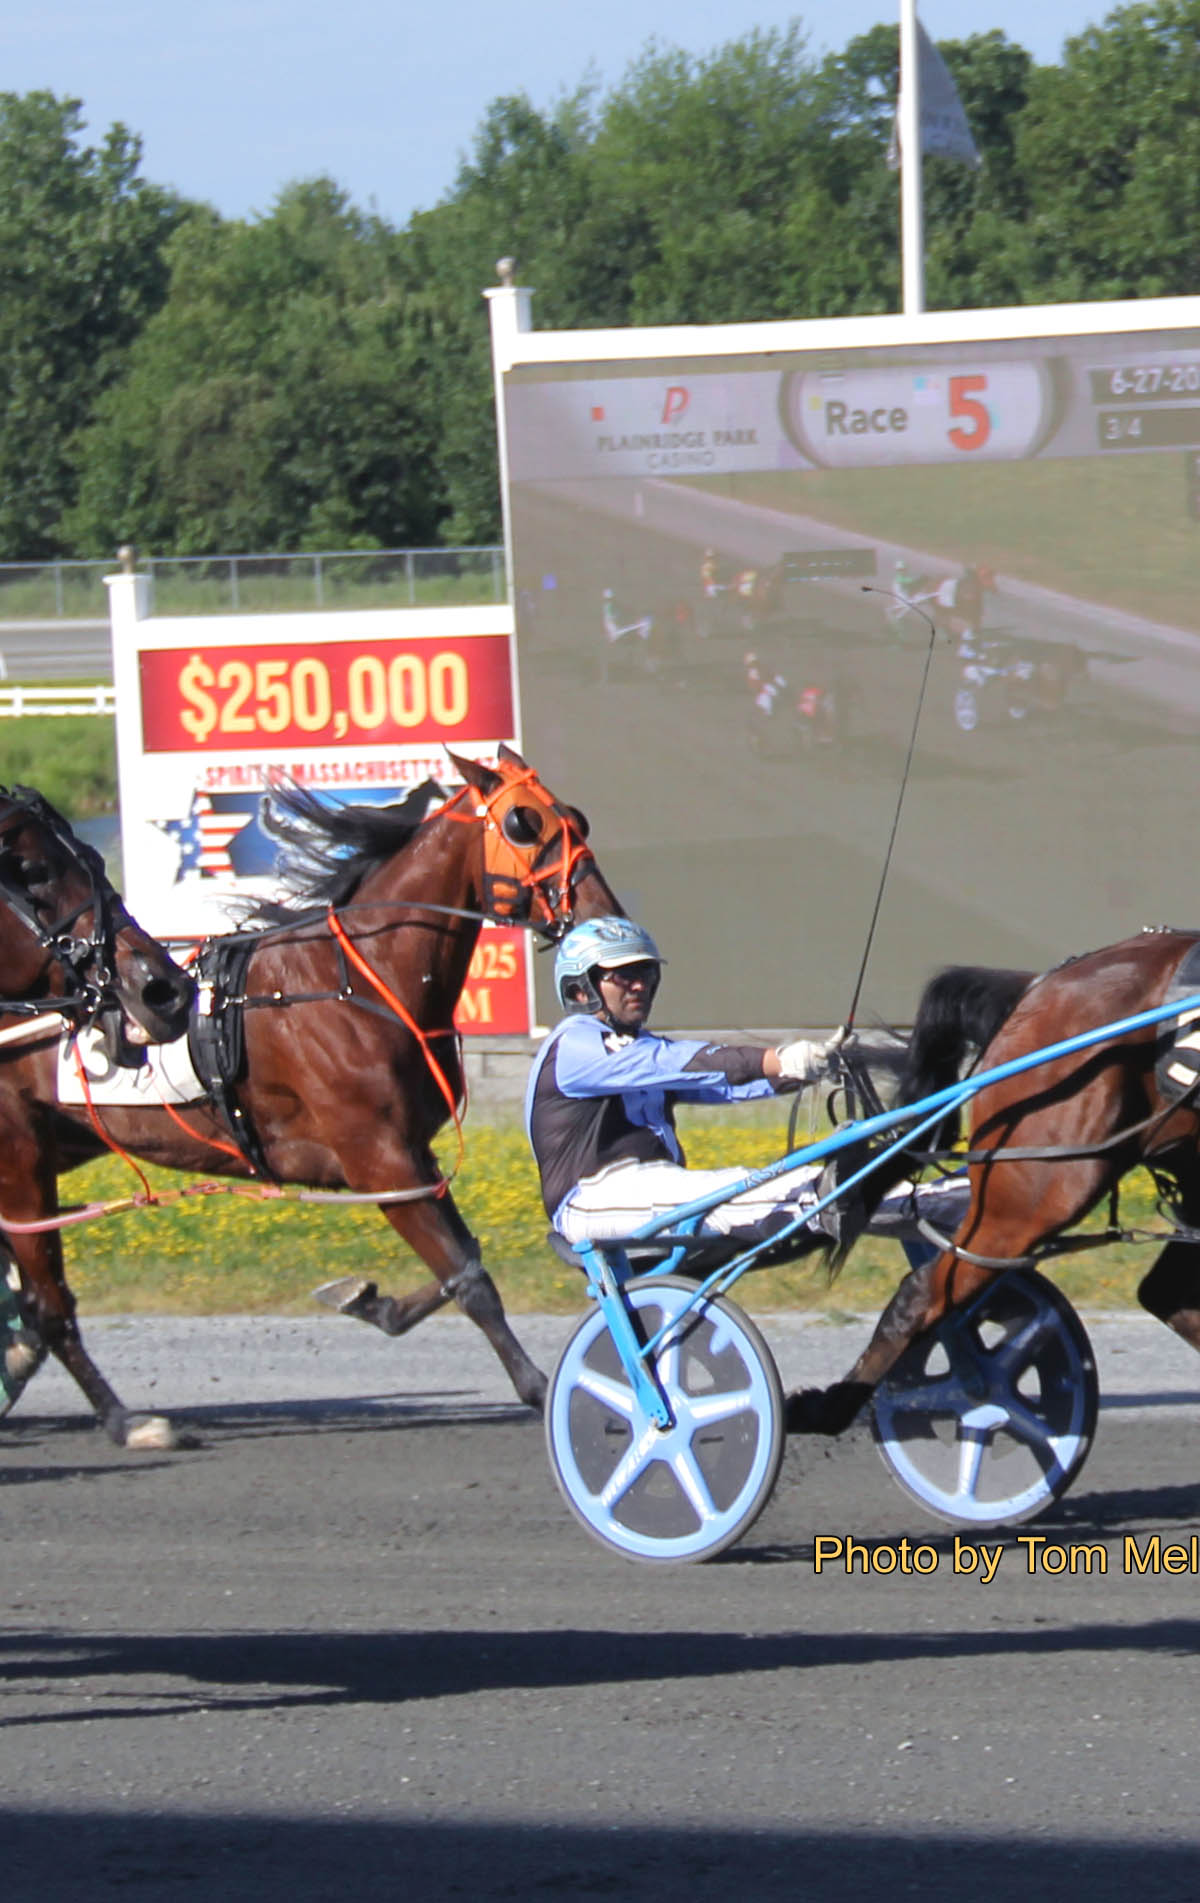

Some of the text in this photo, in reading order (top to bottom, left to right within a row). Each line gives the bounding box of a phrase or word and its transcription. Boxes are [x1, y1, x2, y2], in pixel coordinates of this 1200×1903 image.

[825, 375, 991, 452] Race 5
[597, 428, 759, 451] PLAINRIDGE PARK
[1105, 417, 1143, 440] 3/4
[647, 451, 715, 468] CASINO
[178, 651, 470, 743] $250,000
[291, 757, 444, 785] MASSACHUSETTS
